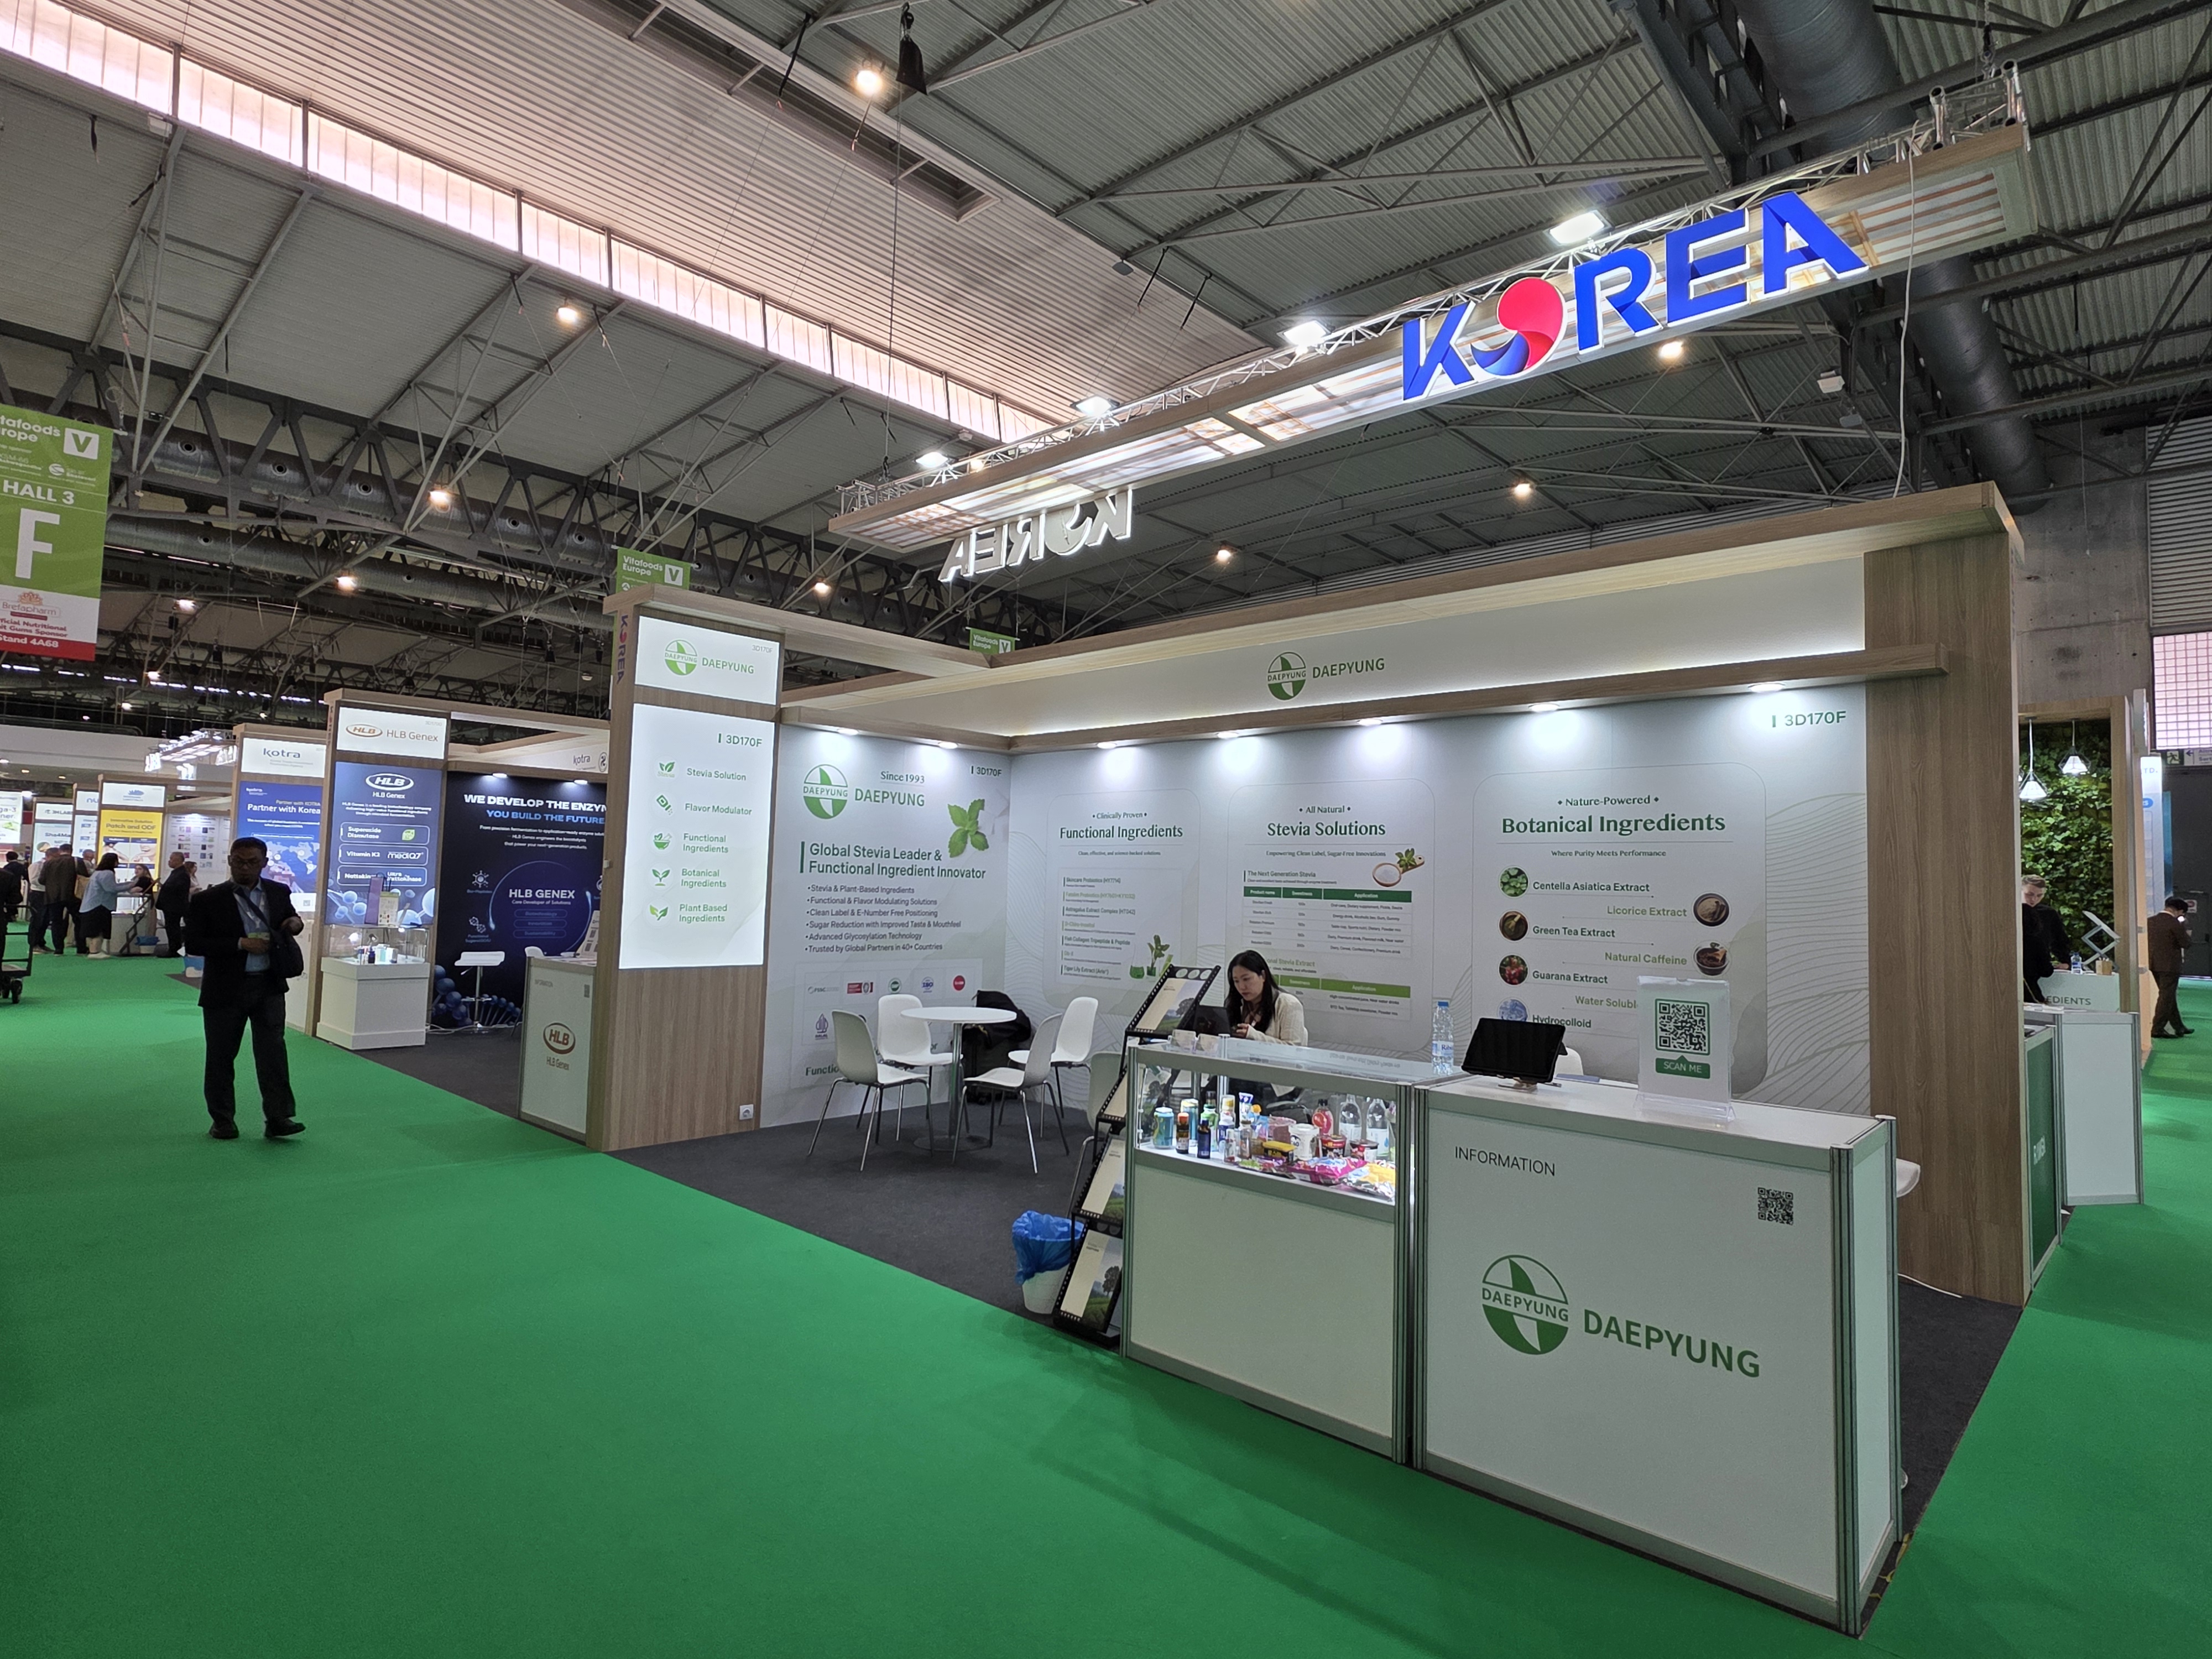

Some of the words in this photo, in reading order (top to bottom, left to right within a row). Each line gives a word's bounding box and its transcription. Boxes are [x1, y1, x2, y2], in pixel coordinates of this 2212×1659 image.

[1402, 191, 1869, 402] KOREA
[0, 415, 61, 437] tafoods
[0, 427, 38, 442] rope
[3, 479, 56, 503] HALL
[63, 491, 74, 505] 3
[15, 508, 60, 579] F
[623, 555, 663, 572] Vitafoods
[623, 563, 651, 577] Europe
[2, 602, 56, 615] Brefapharm
[23, 620, 67, 632] Nutritional
[35, 629, 68, 638] Sponsor
[973, 634, 998, 645] Vitafoods
[30, 638, 59, 648] 4A68
[973, 640, 991, 649] Europe
[752, 645, 773, 654] 3D170F
[665, 652, 697, 664] DAEPYUNG
[702, 657, 754, 675] DAEPYUNG
[1312, 658, 1385, 679] DAEPYUNG
[1267, 670, 1306, 681] DAEPYUNG
[1785, 711, 1846, 726] 3D170F
[353, 726, 376, 734] HLB
[387, 729, 406, 739] HLB
[409, 732, 438, 742] Genex
[726, 734, 763, 747] 3D170F
[264, 748, 300, 758] kotra
[573, 754, 590, 765] kotra
[687, 768, 712, 778] Stevia
[714, 771, 747, 781] Solution
[880, 771, 904, 781] Since
[906, 775, 925, 784] 1993
[977, 766, 1002, 777] 3D170F
[374, 776, 405, 787] HLB
[803, 786, 848, 797] DAEPYUNG
[854, 788, 925, 807] DAEPYUNG
[463, 794, 484, 804] WE
[487, 795, 544, 808] DEVELOP
[546, 800, 569, 810] THE
[1566, 795, 1650, 806] Nature-Powered
[685, 804, 711, 813] Flavor
[712, 806, 752, 816] Modulator
[486, 810, 509, 818] YOU
[511, 811, 541, 821] BUILD
[544, 813, 564, 822] THE
[566, 815, 605, 824] FUTURE
[1267, 821, 1310, 837] Stevia
[1315, 821, 1386, 836] Solutions
[1503, 815, 1593, 833] Botanical
[1600, 813, 1725, 836] Ingredients
[684, 833, 726, 843] Functional
[1060, 826, 1114, 839] Functional
[1118, 825, 1183, 841] Ingredients
[683, 844, 728, 853] Ingredients
[810, 843, 850, 857] Global
[853, 846, 890, 858] Stevia
[894, 848, 932, 860] Leader
[934, 850, 942, 861] &
[1574, 850, 1595, 858] Purity
[682, 869, 719, 877] Botanical
[809, 861, 874, 875] Functional
[878, 863, 935, 878] Ingredient
[937, 865, 986, 879] Innovator
[681, 879, 727, 888] Ingredients
[1533, 881, 1571, 891] Centella
[1573, 881, 1611, 891] Asiatica
[1613, 882, 1650, 892] Extract
[509, 889, 533, 898] HLB
[535, 889, 575, 899] GENEX
[880, 886, 915, 895] Ingredients
[703, 904, 727, 912] Based
[874, 898, 909, 906] Modulating
[905, 910, 938, 918] Positioning
[1608, 905, 1647, 916] Licorice
[1649, 907, 1687, 917] Extract
[679, 915, 725, 924] Ingredients
[809, 921, 830, 930] Sugar
[880, 921, 909, 930] Improved
[844, 932, 887, 941] Glycosylation
[888, 932, 922, 940] Technology
[1532, 926, 1560, 936] Green
[1562, 927, 1578, 936] Tea
[1580, 927, 1615, 937] Extract
[836, 945, 843, 953] by
[1605, 952, 1641, 963] Natural
[1643, 954, 1687, 965] Caffeine
[1532, 970, 1571, 981] Guarana
[1573, 972, 1608, 984] Extract
[1575, 995, 1604, 1006] Water
[1606, 997, 1637, 1009] Solubl
[2047, 995, 2091, 1006] EDIENTS
[1532, 1014, 1592, 1028] Hydrocolloid
[549, 1029, 570, 1046] HLB
[805, 1066, 839, 1076] Functio
[1663, 1061, 1686, 1072] SCAN
[1689, 1063, 1702, 1073] ME
[1454, 1146, 1556, 1176] INFORMATION
[1482, 1287, 1569, 1322] DAEPYUNG
[1584, 1309, 1760, 1378] DAEPYUNG
